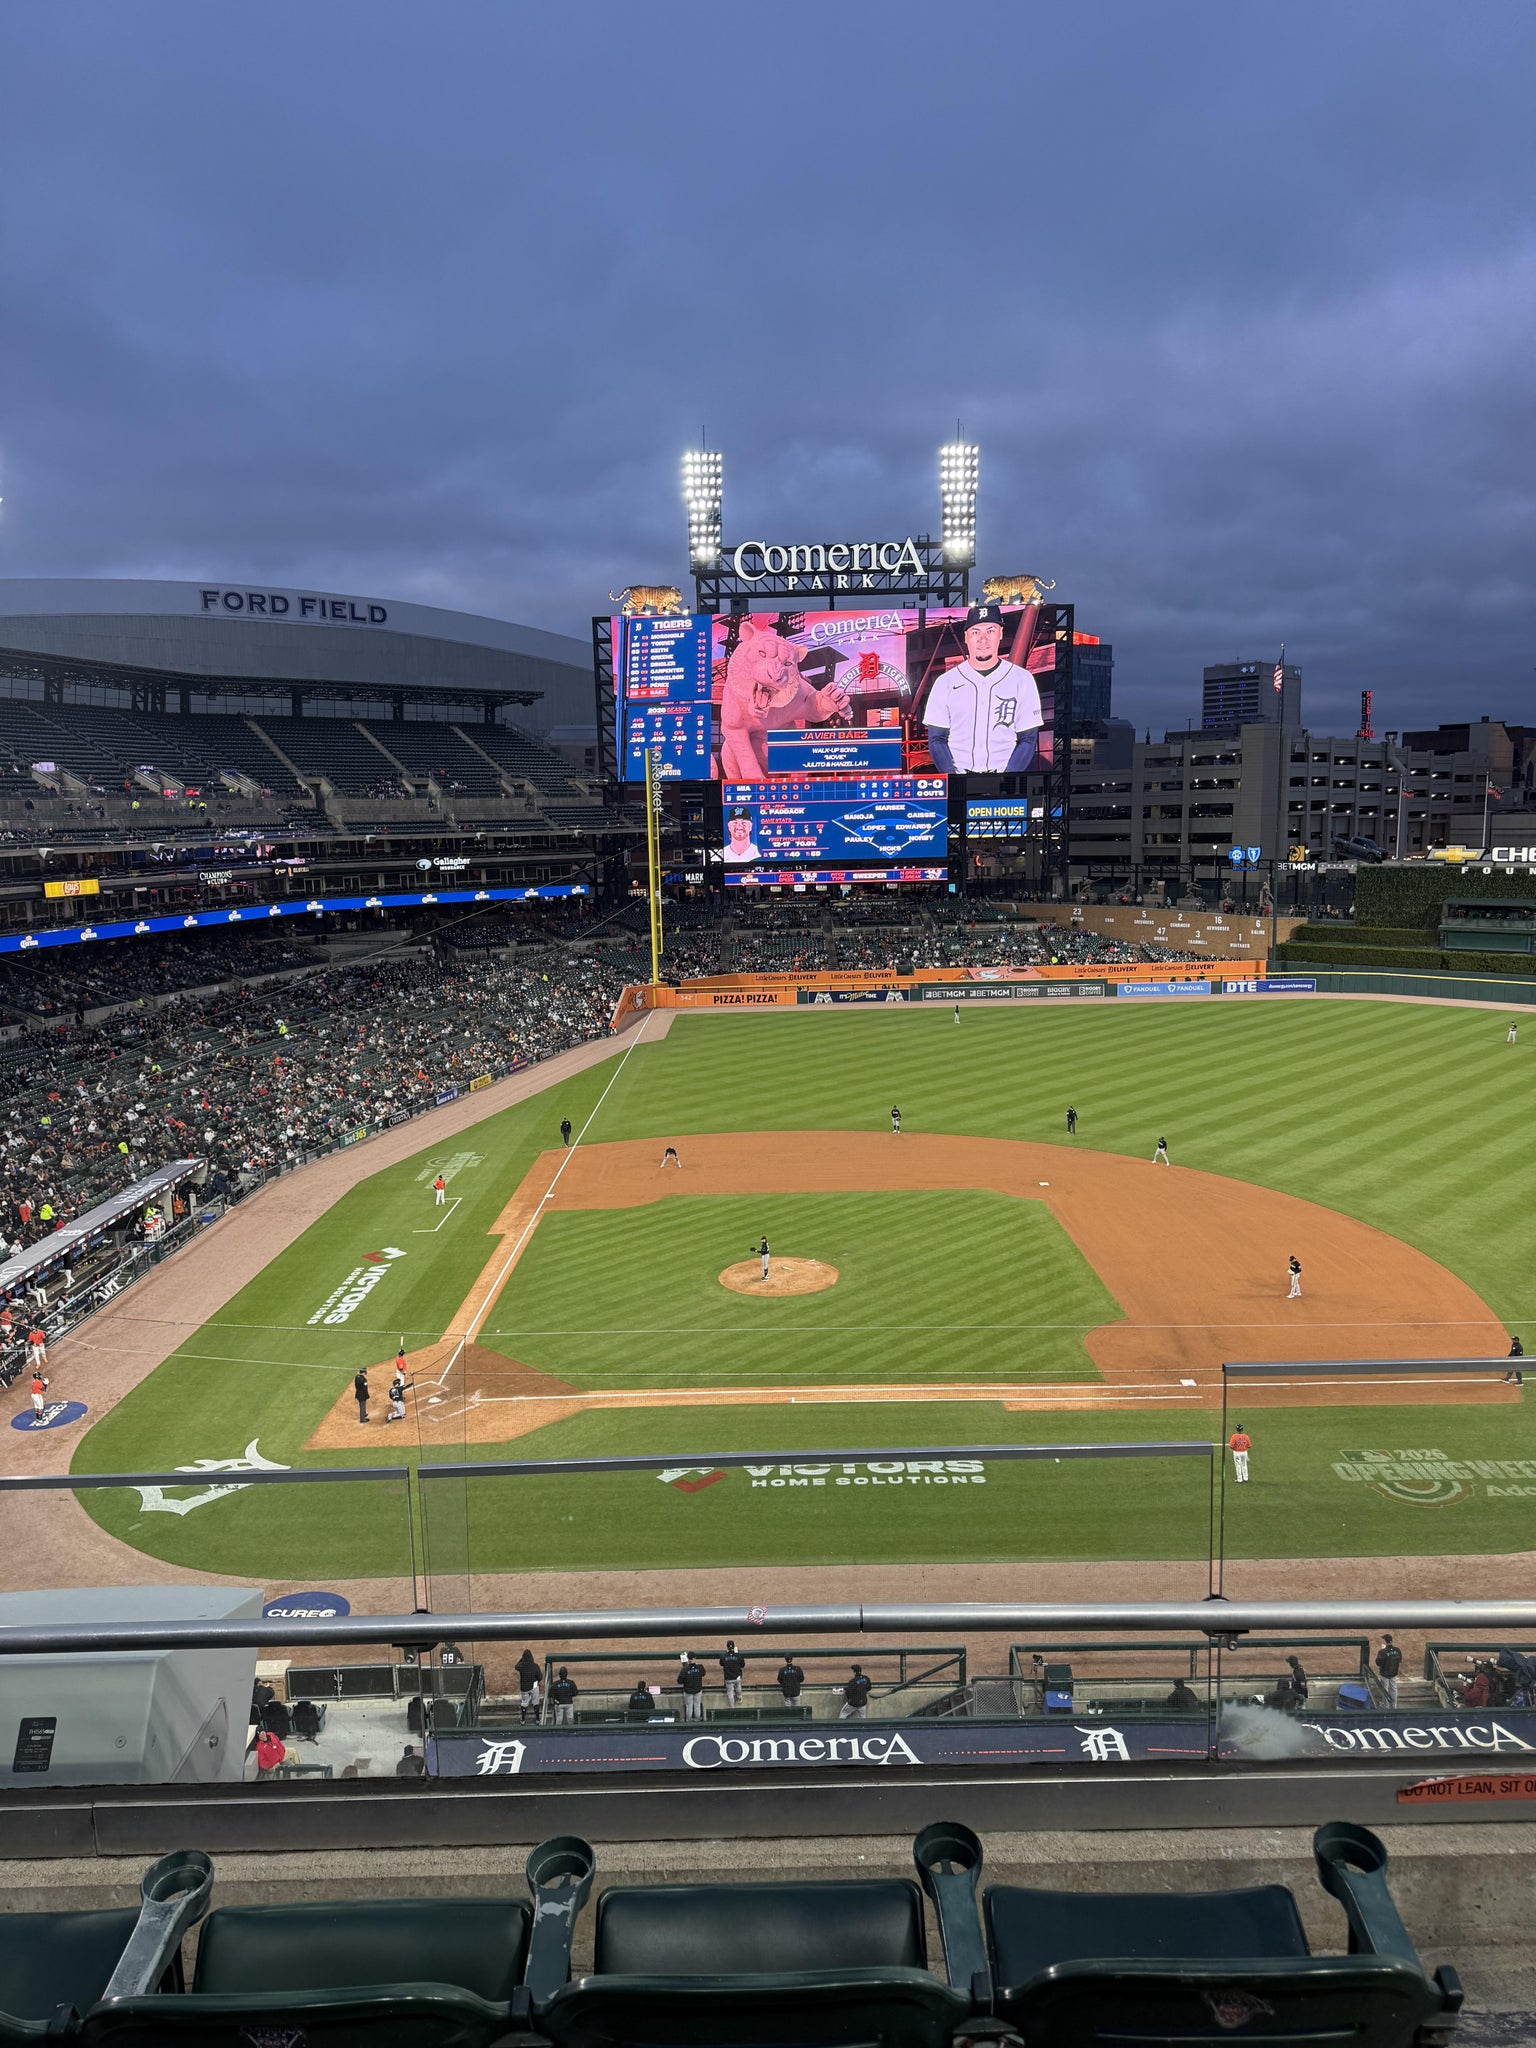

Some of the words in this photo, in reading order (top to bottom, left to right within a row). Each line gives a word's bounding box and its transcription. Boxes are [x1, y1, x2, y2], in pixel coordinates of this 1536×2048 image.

[787, 573, 875, 590] PARK
[200, 589, 290, 616] FORD
[298, 595, 388, 624] FIELD
[652, 619, 693, 629] TIGERS
[837, 634, 880, 646] PARK
[881, 664, 910, 692] TIGERS
[666, 706, 691, 714] SEASON
[800, 731, 836, 740] JAVIER
[1359, 730, 1375, 738] HALL
[651, 763, 665, 813] Rocket
[917, 779, 943, 789] 0-0
[968, 807, 992, 817] OPEN
[993, 806, 1025, 816] HOUSE
[433, 856, 471, 866] Gallagher
[1277, 862, 1316, 871] BETMGM
[199, 870, 233, 881] CHAMPIONS
[685, 872, 704, 882] MARK
[1141, 910, 1147, 918] 5
[1177, 913, 1183, 921] 2
[1214, 916, 1223, 924] 16
[1255, 920, 1261, 928] 6
[1157, 927, 1166, 935] 47
[1195, 930, 1201, 938] 3
[1238, 933, 1242, 941] 1
[1185, 963, 1215, 971] DELIVERY
[788, 973, 817, 981] DELIVERY
[1227, 981, 1257, 993] DTE
[932, 990, 966, 998] BETMGM
[976, 989, 1010, 997] BETMGM
[713, 994, 745, 1004] PIZZA!
[746, 993, 778, 1003] PIZZA!
[344, 1128, 367, 1145] bet365
[341, 1266, 365, 1286] HOME
[323, 1263, 393, 1324] VICTORS
[306, 1286, 348, 1325] SOLUTIONS
[743, 1459, 985, 1476] VICTORS
[1330, 1461, 1475, 1481] OPENING
[752, 1478, 826, 1487] HOME
[835, 1475, 987, 1486] SOLUTIONS
[442, 1653, 454, 1664] 88
[1427, 1782, 1455, 1796] NOT
[1457, 1781, 1496, 1796] LEAN,
[1499, 1780, 1521, 1793] SIT
